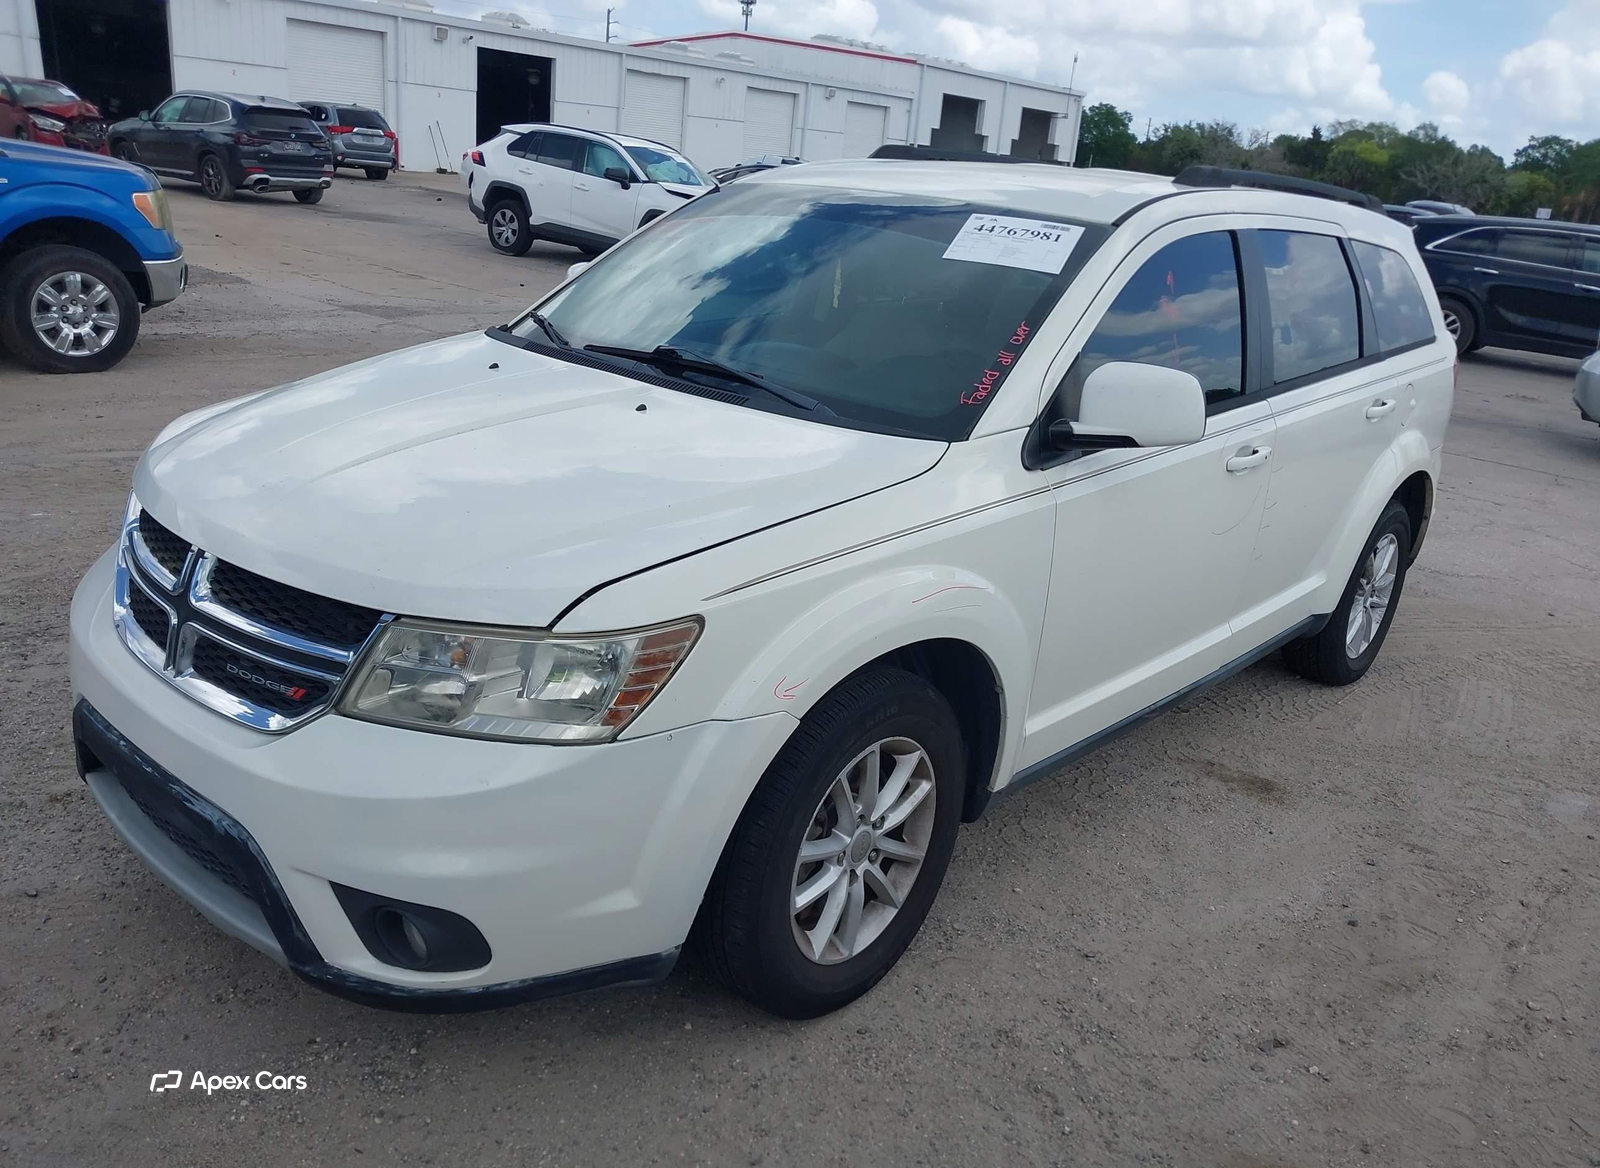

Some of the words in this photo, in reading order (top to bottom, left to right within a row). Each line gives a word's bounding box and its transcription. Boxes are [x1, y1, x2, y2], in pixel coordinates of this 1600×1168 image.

[973, 223, 1062, 243] 44767981
[960, 369, 1000, 405] Faded
[997, 350, 1016, 365] all
[226, 663, 295, 696] DODGE
